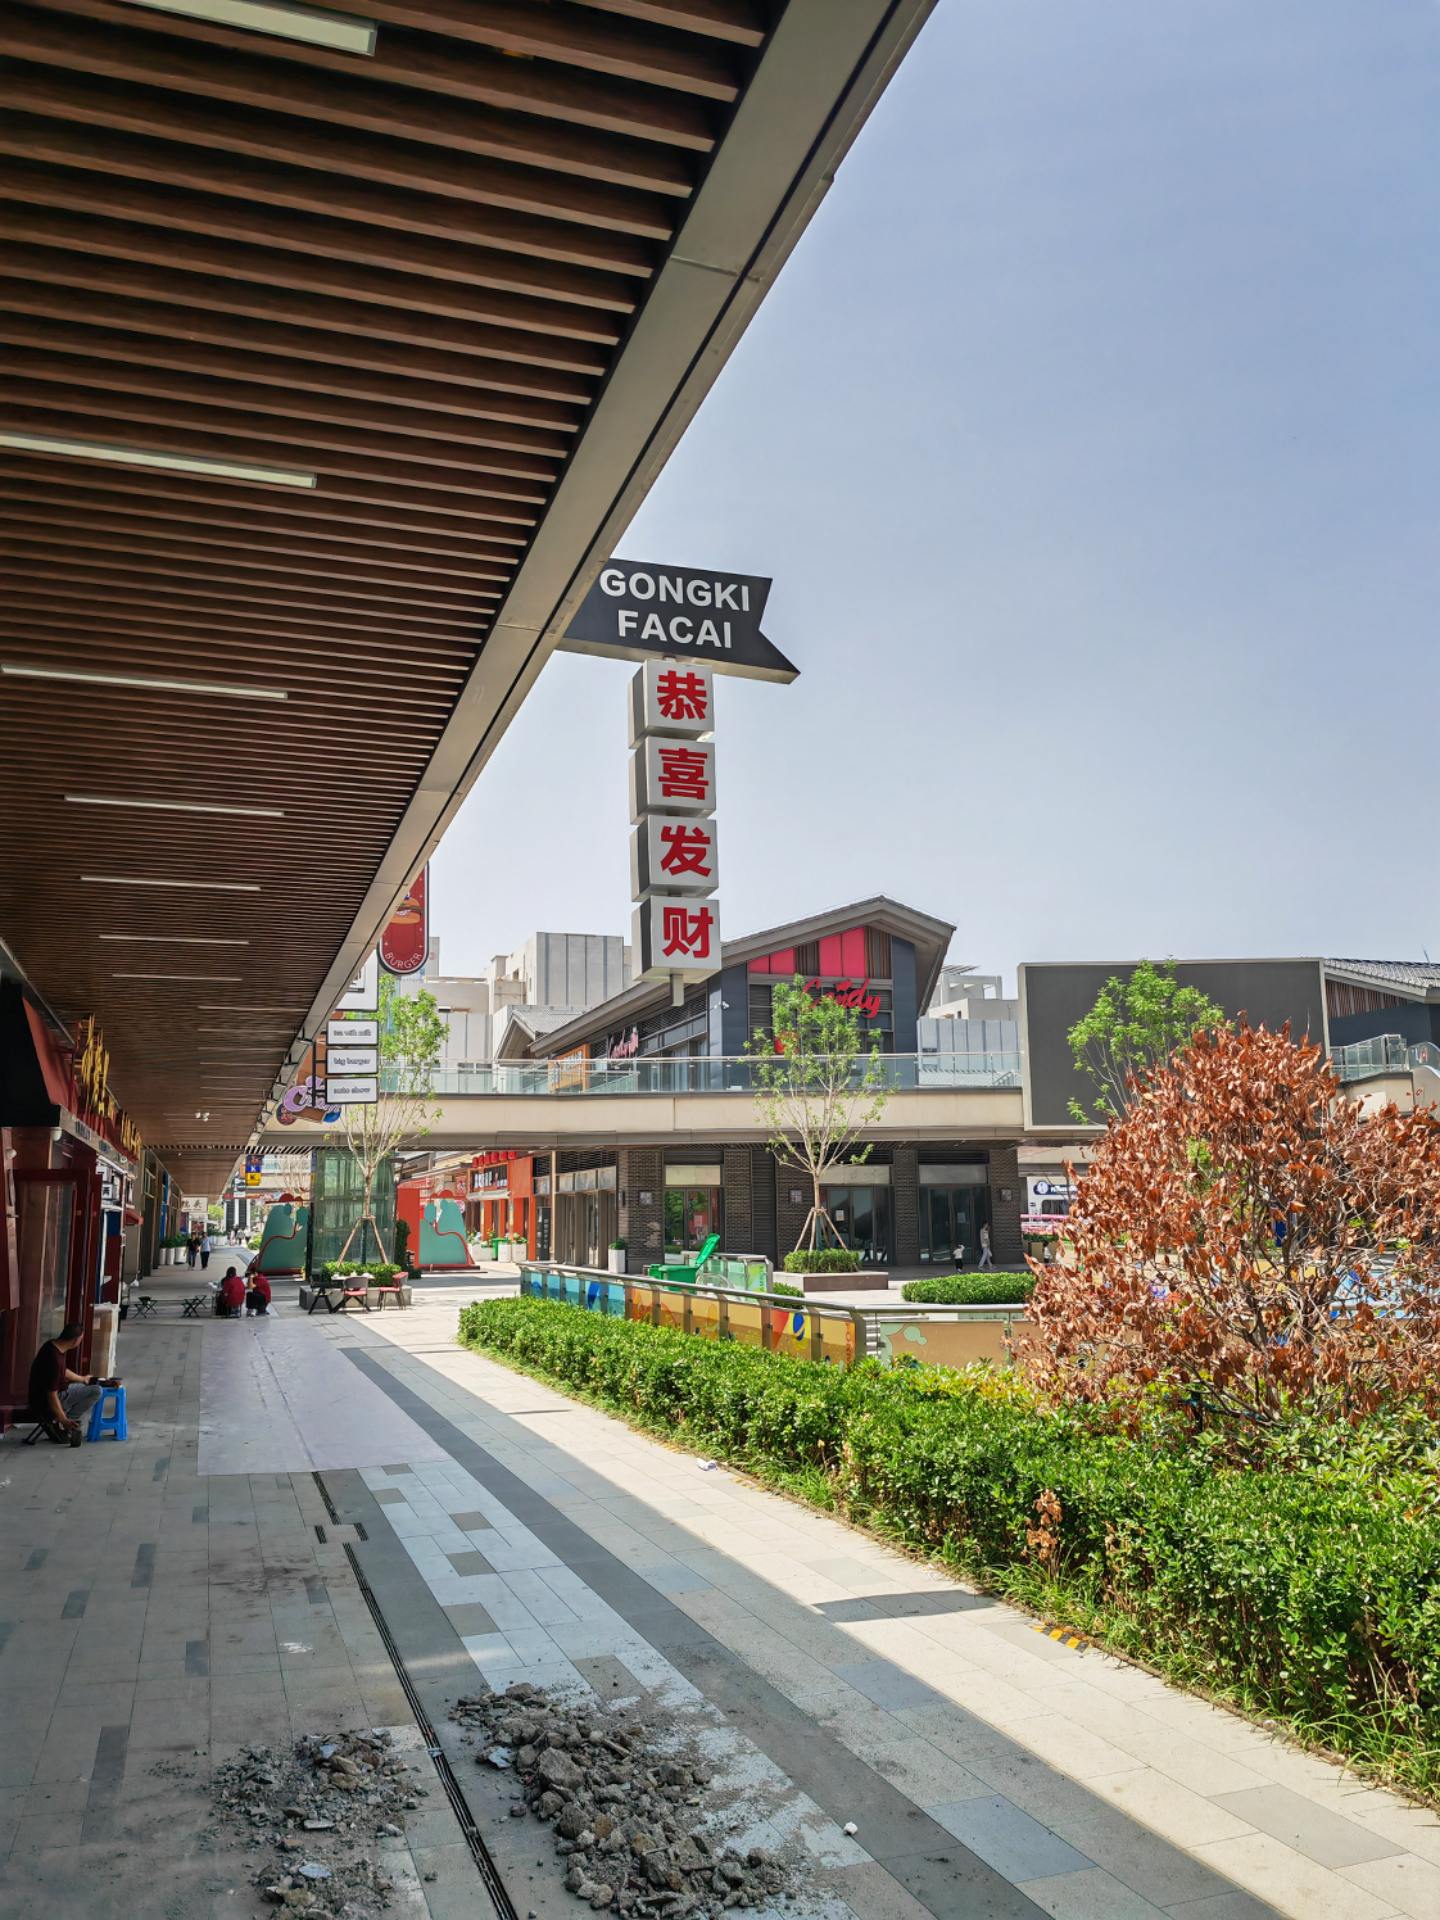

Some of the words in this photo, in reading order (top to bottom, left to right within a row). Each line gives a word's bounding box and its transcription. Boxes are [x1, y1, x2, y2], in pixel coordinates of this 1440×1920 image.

[599, 568, 750, 612] GONGKI
[618, 609, 732, 649] FACAI
[656, 669, 715, 959] 恭喜发财
[385, 952, 422, 969] BURGER
[346, 1057, 371, 1066] burger
